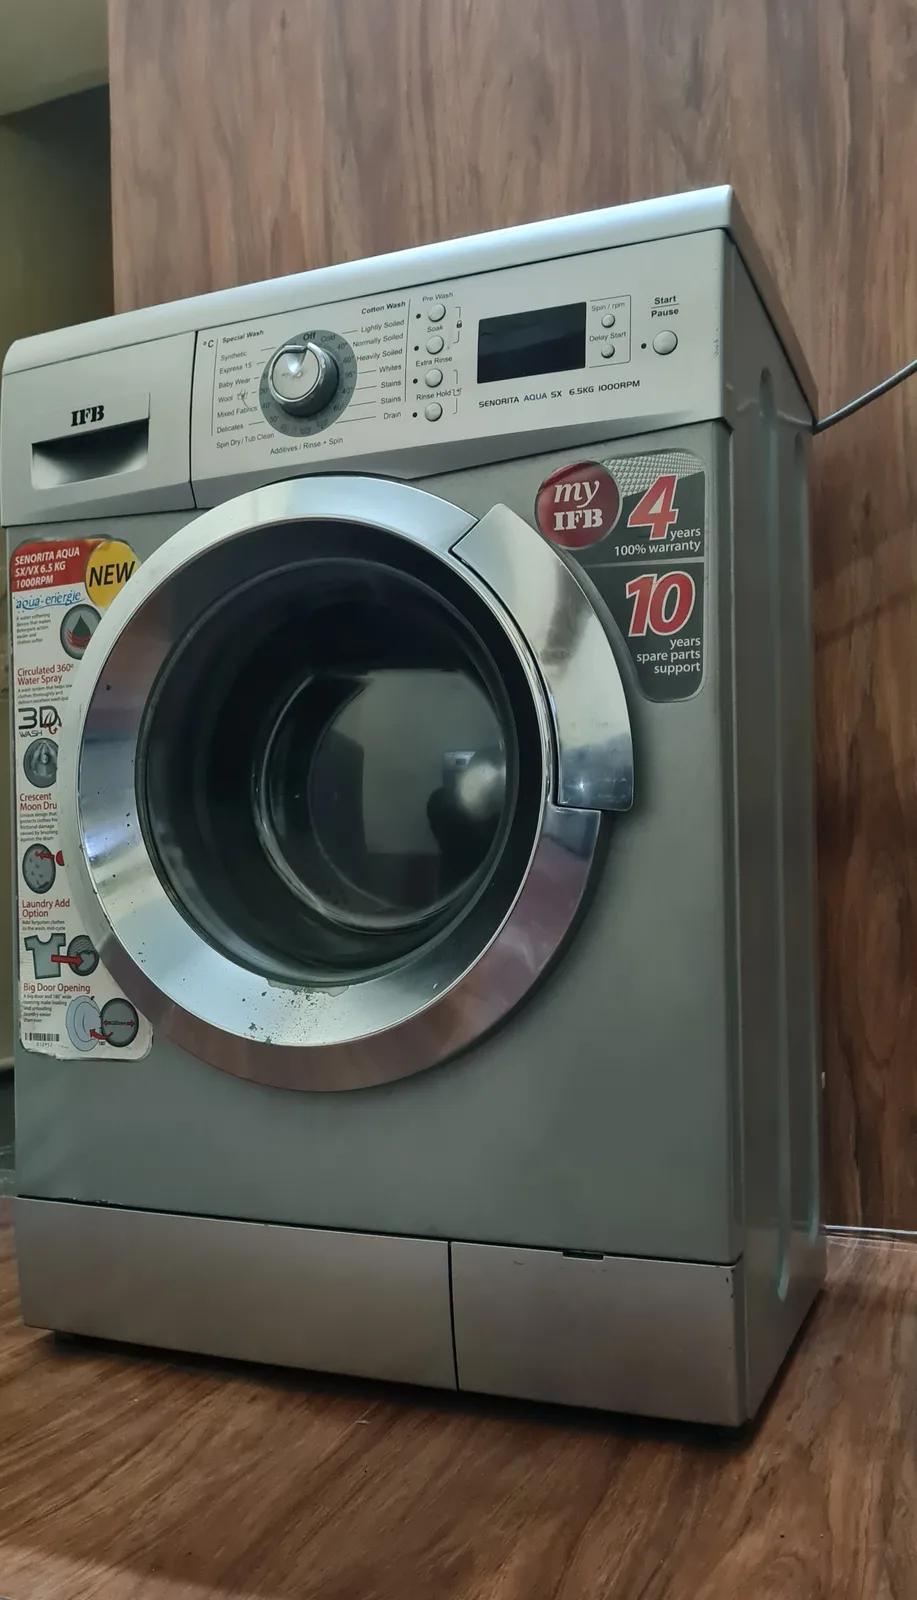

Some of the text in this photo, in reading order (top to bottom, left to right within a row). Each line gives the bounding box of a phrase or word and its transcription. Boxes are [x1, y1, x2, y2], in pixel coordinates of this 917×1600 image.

[434, 292, 454, 300] Wash
[654, 295, 677, 305] Start
[361, 301, 406, 315] Cotton Wash
[591, 304, 606, 312] Spin
[612, 302, 626, 310] rpm
[651, 308, 680, 318] Pause
[360, 319, 404, 334] Lightly Soiled
[427, 324, 444, 333] Soak
[222, 330, 264, 344] Special Wash
[302, 332, 316, 341] Off
[320, 334, 336, 343] Cold
[352, 333, 404, 349] Normally Soiled
[588, 330, 627, 342] Delay Start
[220, 350, 248, 362] Synthetic
[356, 348, 403, 363] Heavily Soiled
[416, 356, 453, 368] Extra Rinse
[219, 362, 252, 375] Express 15
[379, 364, 402, 374] Whites
[218, 376, 252, 390] Baby Wear
[380, 380, 402, 389] Stains
[218, 394, 234, 403] Wool
[380, 395, 402, 405] Stains
[416, 389, 452, 401] Rinse Hold
[478, 380, 641, 408] SENORITA AQUA SX 6.5KG 1000RPM
[70, 404, 105, 427] IFB
[217, 404, 258, 418] Mixed Fabrics
[383, 410, 402, 420] Drain
[216, 422, 244, 434] Delicates
[216, 439, 230, 450] Spin
[230, 437, 240, 448] Dry
[245, 434, 256, 444] Tub
[256, 432, 275, 442] Clean
[270, 442, 298, 456] Additives
[303, 440, 322, 450] Rinse
[328, 436, 344, 448] Spin
[554, 480, 600, 508] my
[627, 474, 679, 541] 4
[554, 508, 603, 531] IFB
[670, 527, 701, 541] years
[614, 540, 701, 556] 100% warranty
[14, 546, 80, 566] SENORITA AQUA
[15, 560, 66, 578] SX/VX 6.5 KG
[88, 560, 136, 588] NEW
[16, 575, 54, 589] 1000RPM
[16, 590, 81, 610] aqua-energie
[626, 570, 696, 637] 10
[670, 636, 701, 649] years
[636, 648, 701, 664] spare parts
[18, 664, 56, 677] Circulated
[654, 662, 701, 676] support
[18, 674, 62, 686] Water Spray
[19, 730, 42, 738] WASH
[20, 792, 52, 802] Crescent
[20, 801, 57, 810] Moon Dru
[22, 898, 70, 910] Laundry Add
[22, 909, 49, 918] Option
[23, 984, 91, 994] Big Door Opening
